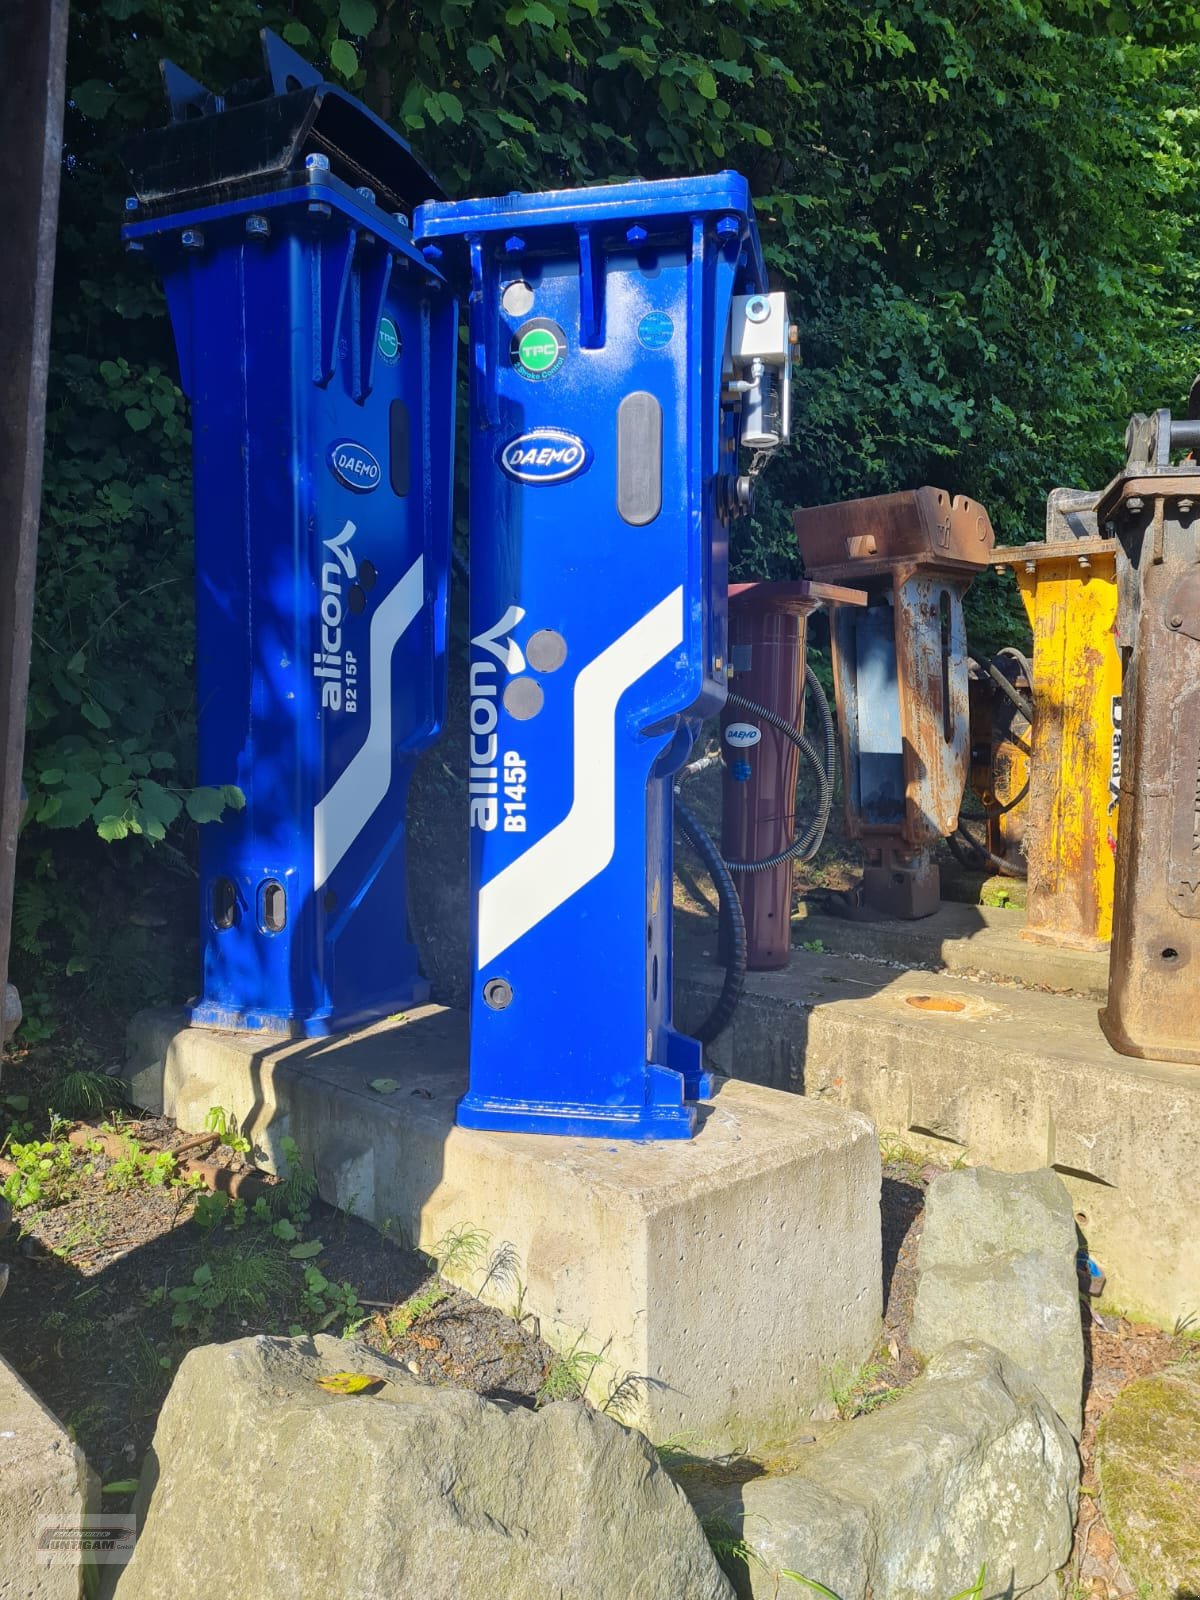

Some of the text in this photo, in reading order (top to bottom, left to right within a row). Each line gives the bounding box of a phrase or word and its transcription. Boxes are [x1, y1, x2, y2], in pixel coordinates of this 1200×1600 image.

[379, 330, 396, 346] TPC
[522, 344, 555, 357] TPC
[518, 366, 541, 380] Stroke
[541, 356, 565, 378] Control
[338, 454, 378, 478] DAEMO
[509, 446, 578, 466] DAEMO
[313, 562, 342, 711] alicon
[345, 650, 357, 713] B215P
[468, 661, 498, 832] alicon
[727, 730, 757, 741] DAEMO
[503, 750, 527, 833] B145P
